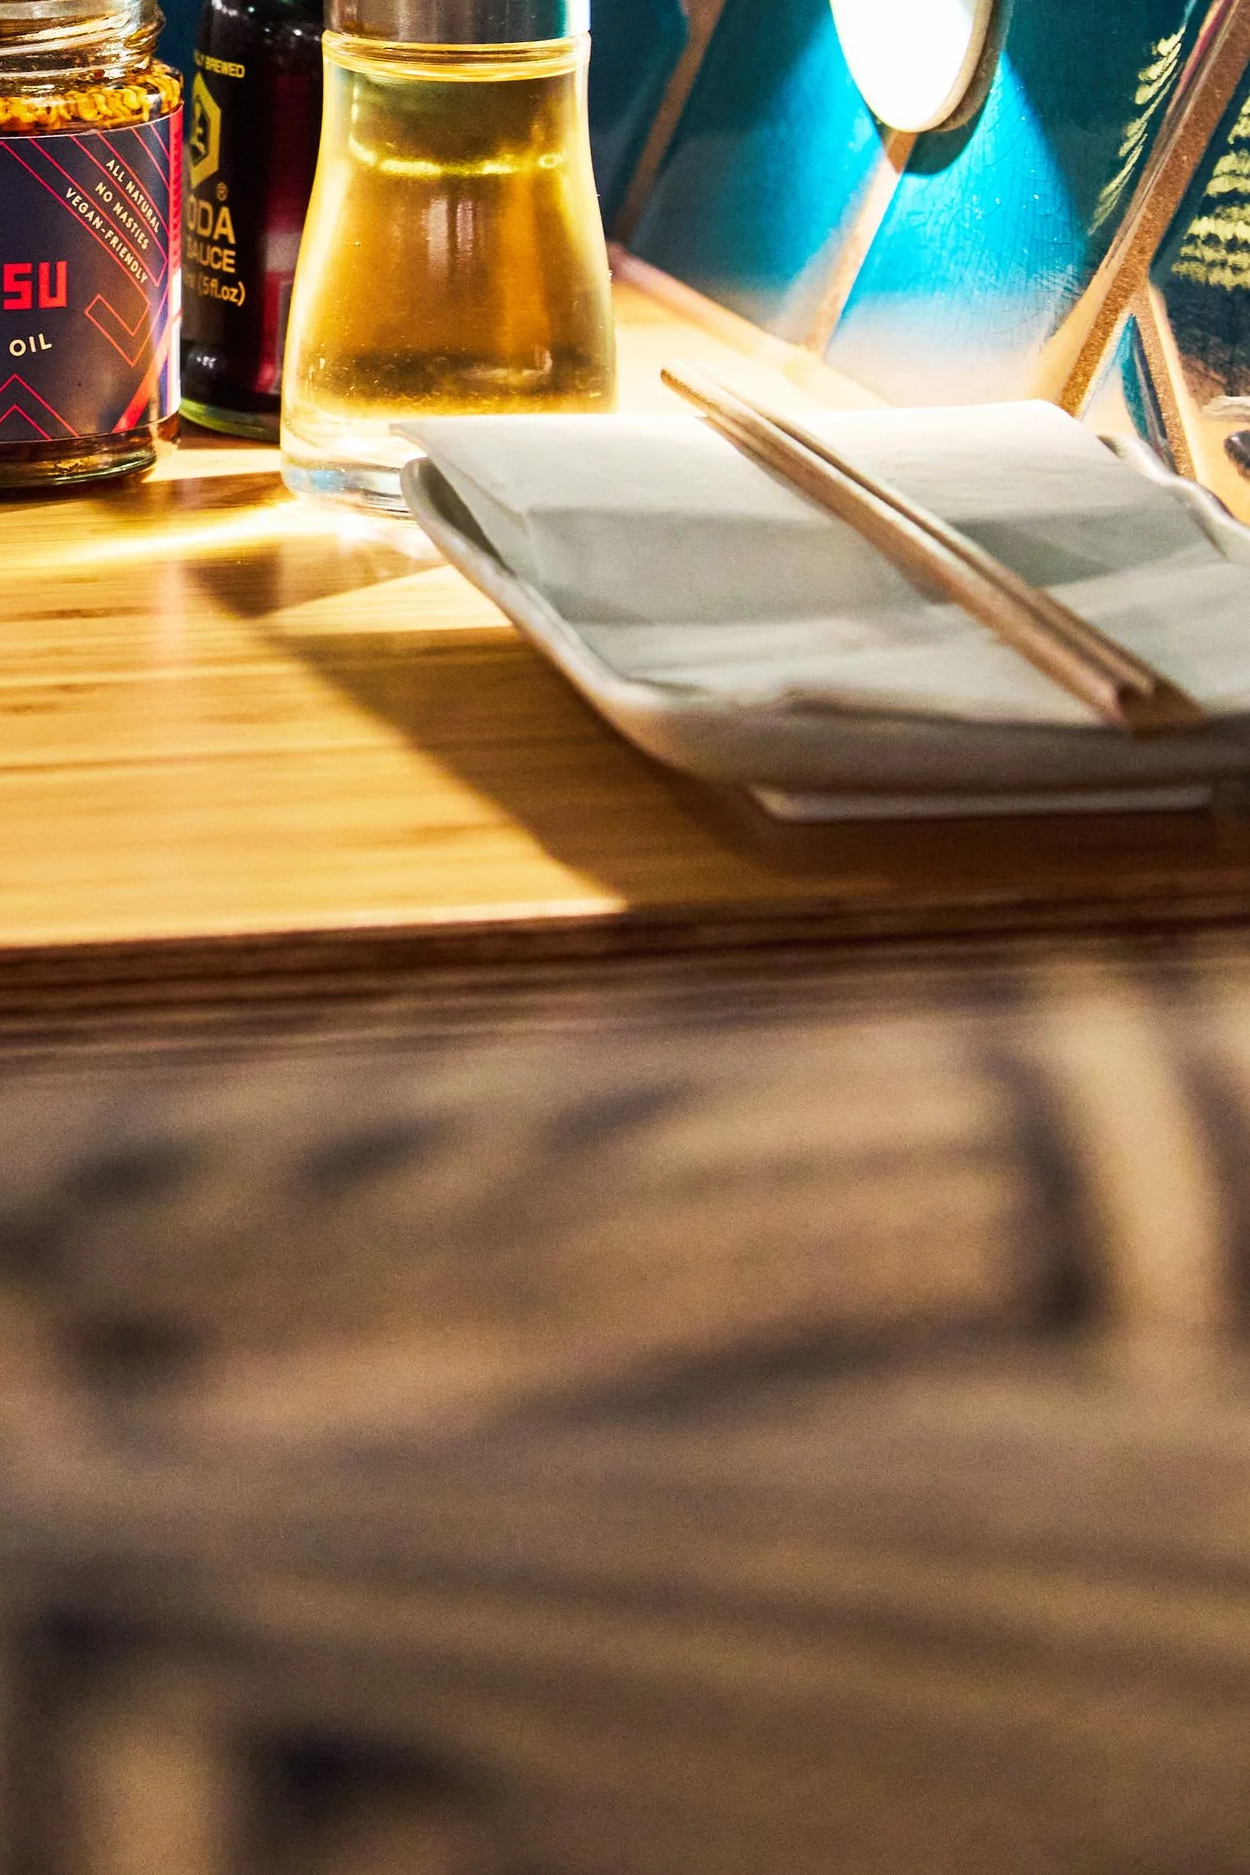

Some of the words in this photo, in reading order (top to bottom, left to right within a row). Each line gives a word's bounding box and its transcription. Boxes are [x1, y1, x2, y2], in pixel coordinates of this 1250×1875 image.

[204, 55, 246, 78] BREWED
[94, 182, 114, 203] NO
[113, 202, 149, 250] NASTIES
[105, 159, 125, 183] ALL
[125, 180, 160, 234] NATURAL
[186, 194, 236, 245] ODA
[65, 187, 148, 284] VEGAN-FRIENDLY
[9, 333, 53, 358] OIL
